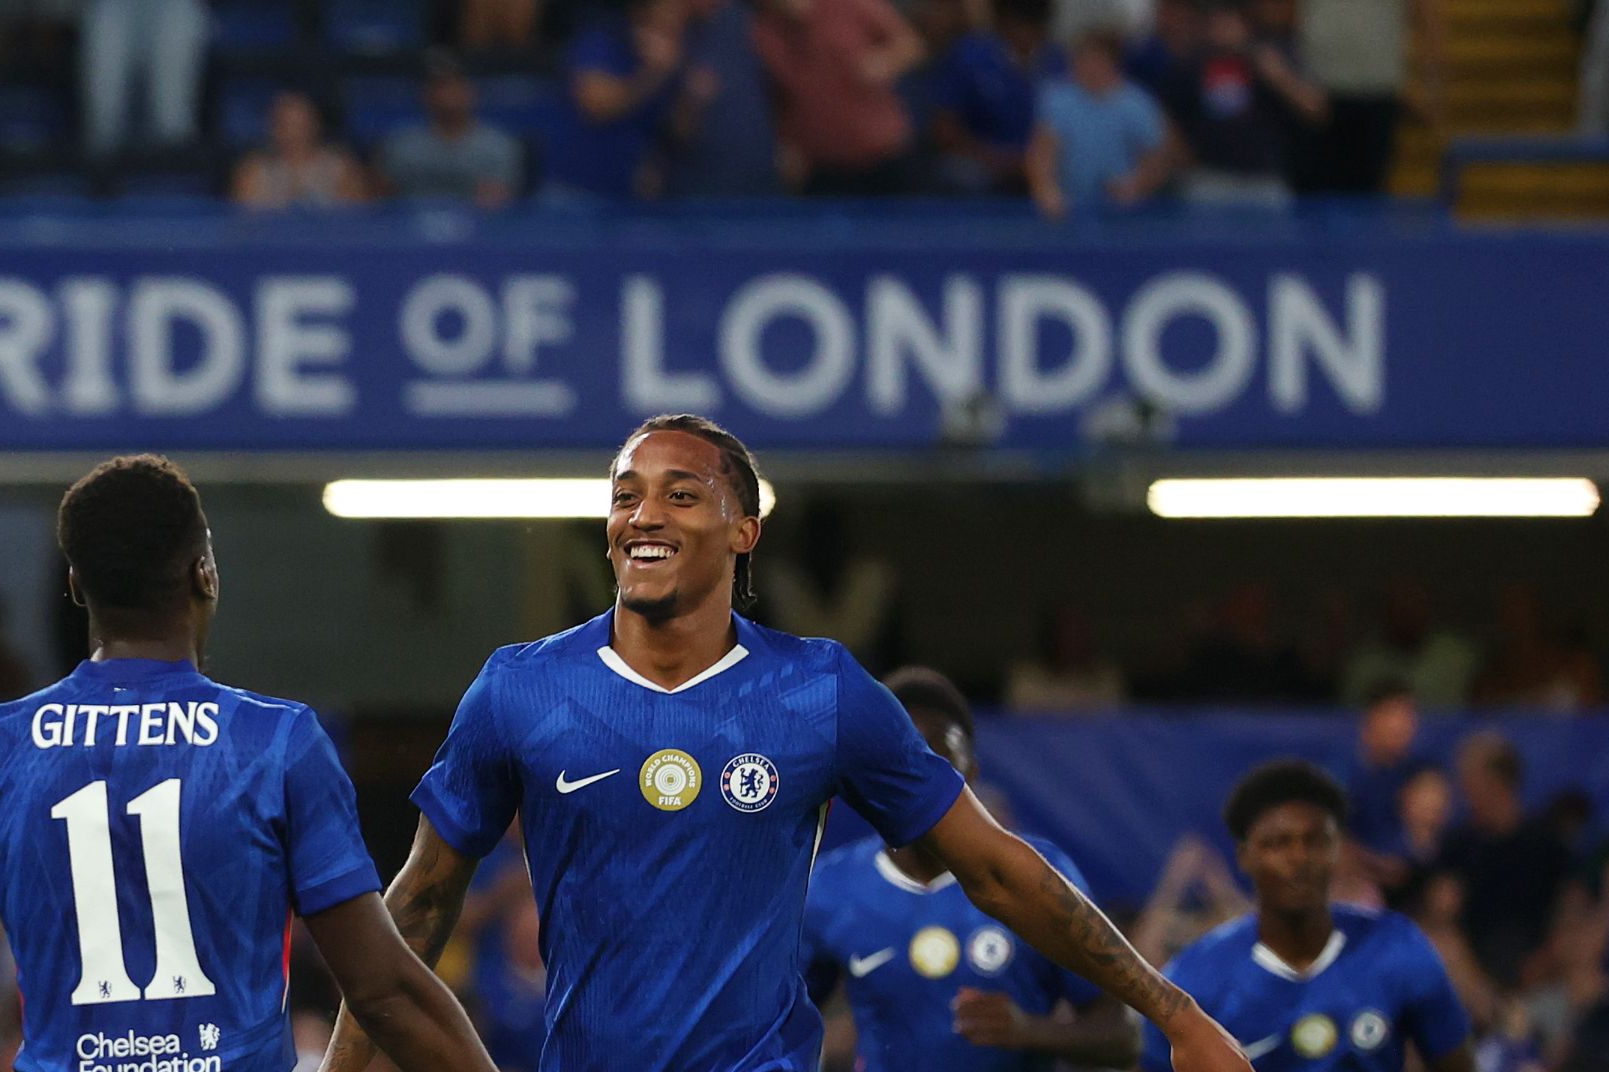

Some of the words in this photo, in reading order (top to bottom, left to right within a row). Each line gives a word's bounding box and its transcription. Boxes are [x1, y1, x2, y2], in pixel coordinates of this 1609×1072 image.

[398, 273, 573, 376] OF
[620, 273, 1385, 414] LONDON
[31, 701, 219, 749] GITTENS
[645, 759, 661, 787] WORLD
[662, 754, 696, 788] CHAMPIONS
[732, 756, 770, 770] CHELSEA
[658, 796, 682, 806] FIFA
[51, 778, 216, 1006] 11
[76, 1029, 180, 1060] Chelsea
